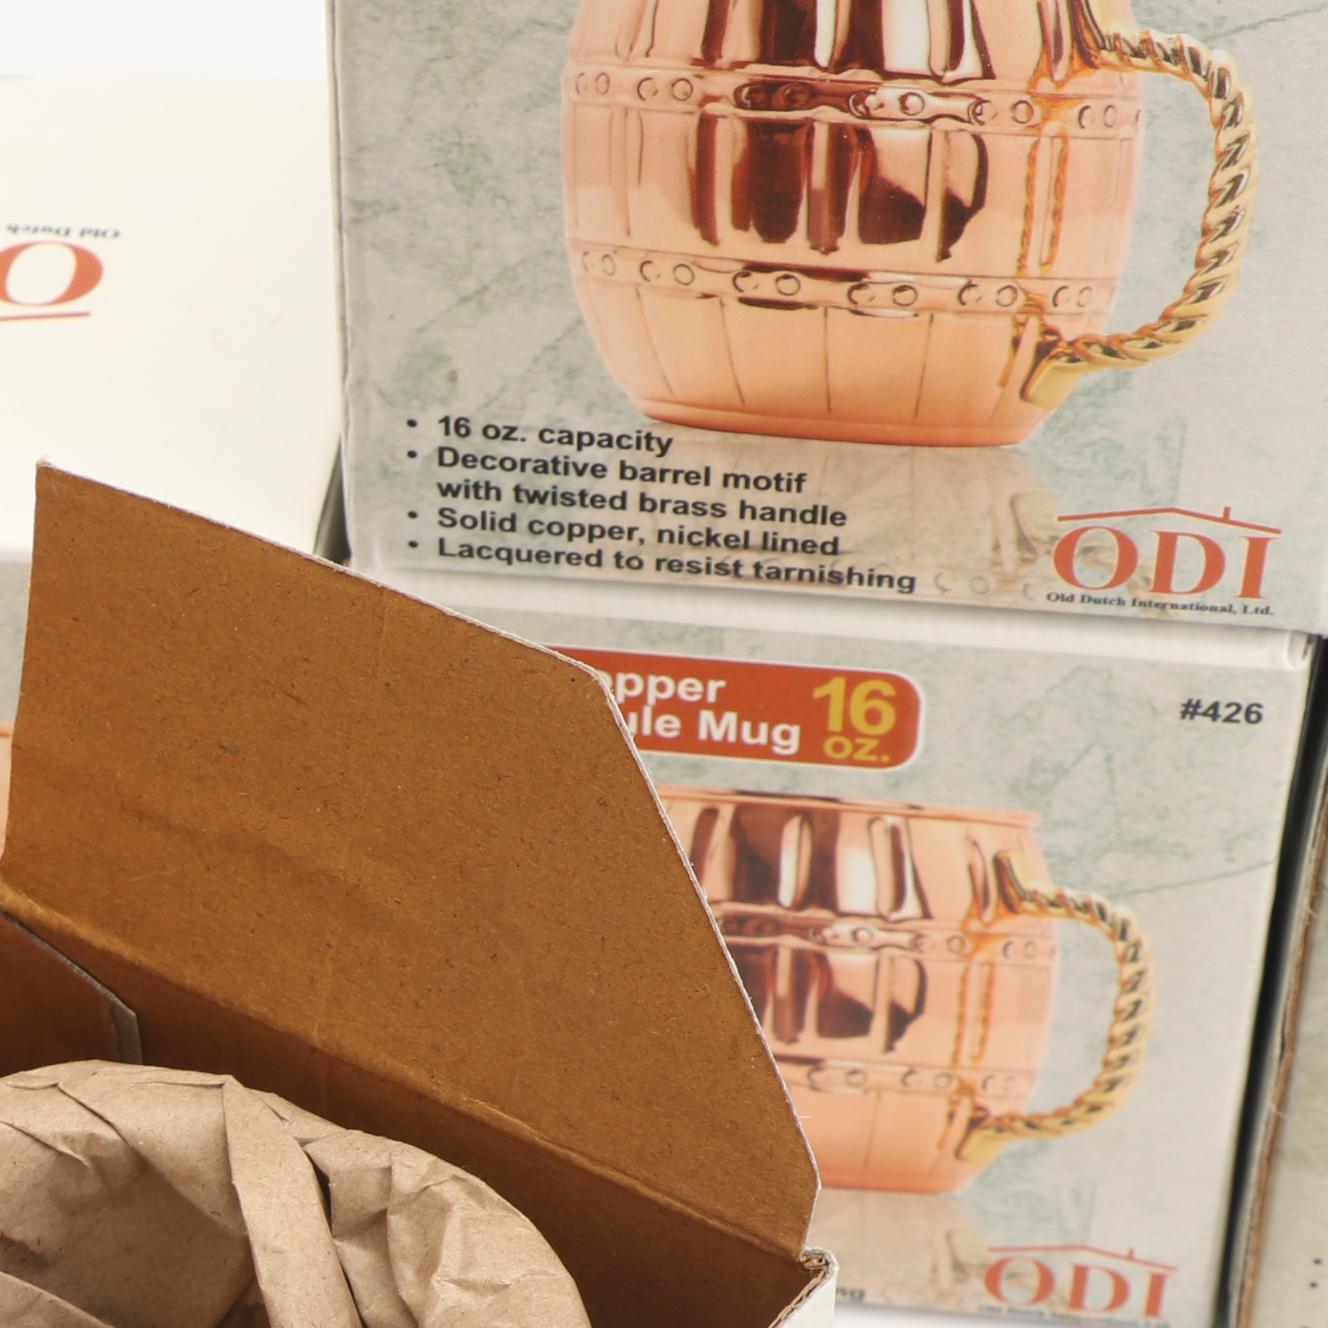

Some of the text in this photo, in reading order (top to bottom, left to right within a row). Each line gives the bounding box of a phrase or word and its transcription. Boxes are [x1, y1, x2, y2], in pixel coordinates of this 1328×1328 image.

[7, 222, 71, 238] Dutch
[437, 415, 674, 457] 16 oz. capacity
[437, 447, 808, 494] Decorative barrel motif
[437, 478, 848, 528] with twisted brass handle
[437, 506, 840, 557] Solid copper, nickel lined
[437, 538, 917, 595] Lacquered to resist tarnishing
[1052, 524, 1279, 600] ODI
[1045, 591, 1274, 616] Old Dutch International, Ltd.
[598, 669, 727, 706] pper
[812, 675, 897, 737] 16
[1180, 697, 1264, 725] #426
[698, 709, 802, 756] Mug
[822, 734, 891, 763] oz.
[983, 1256, 1169, 1319] ODI
